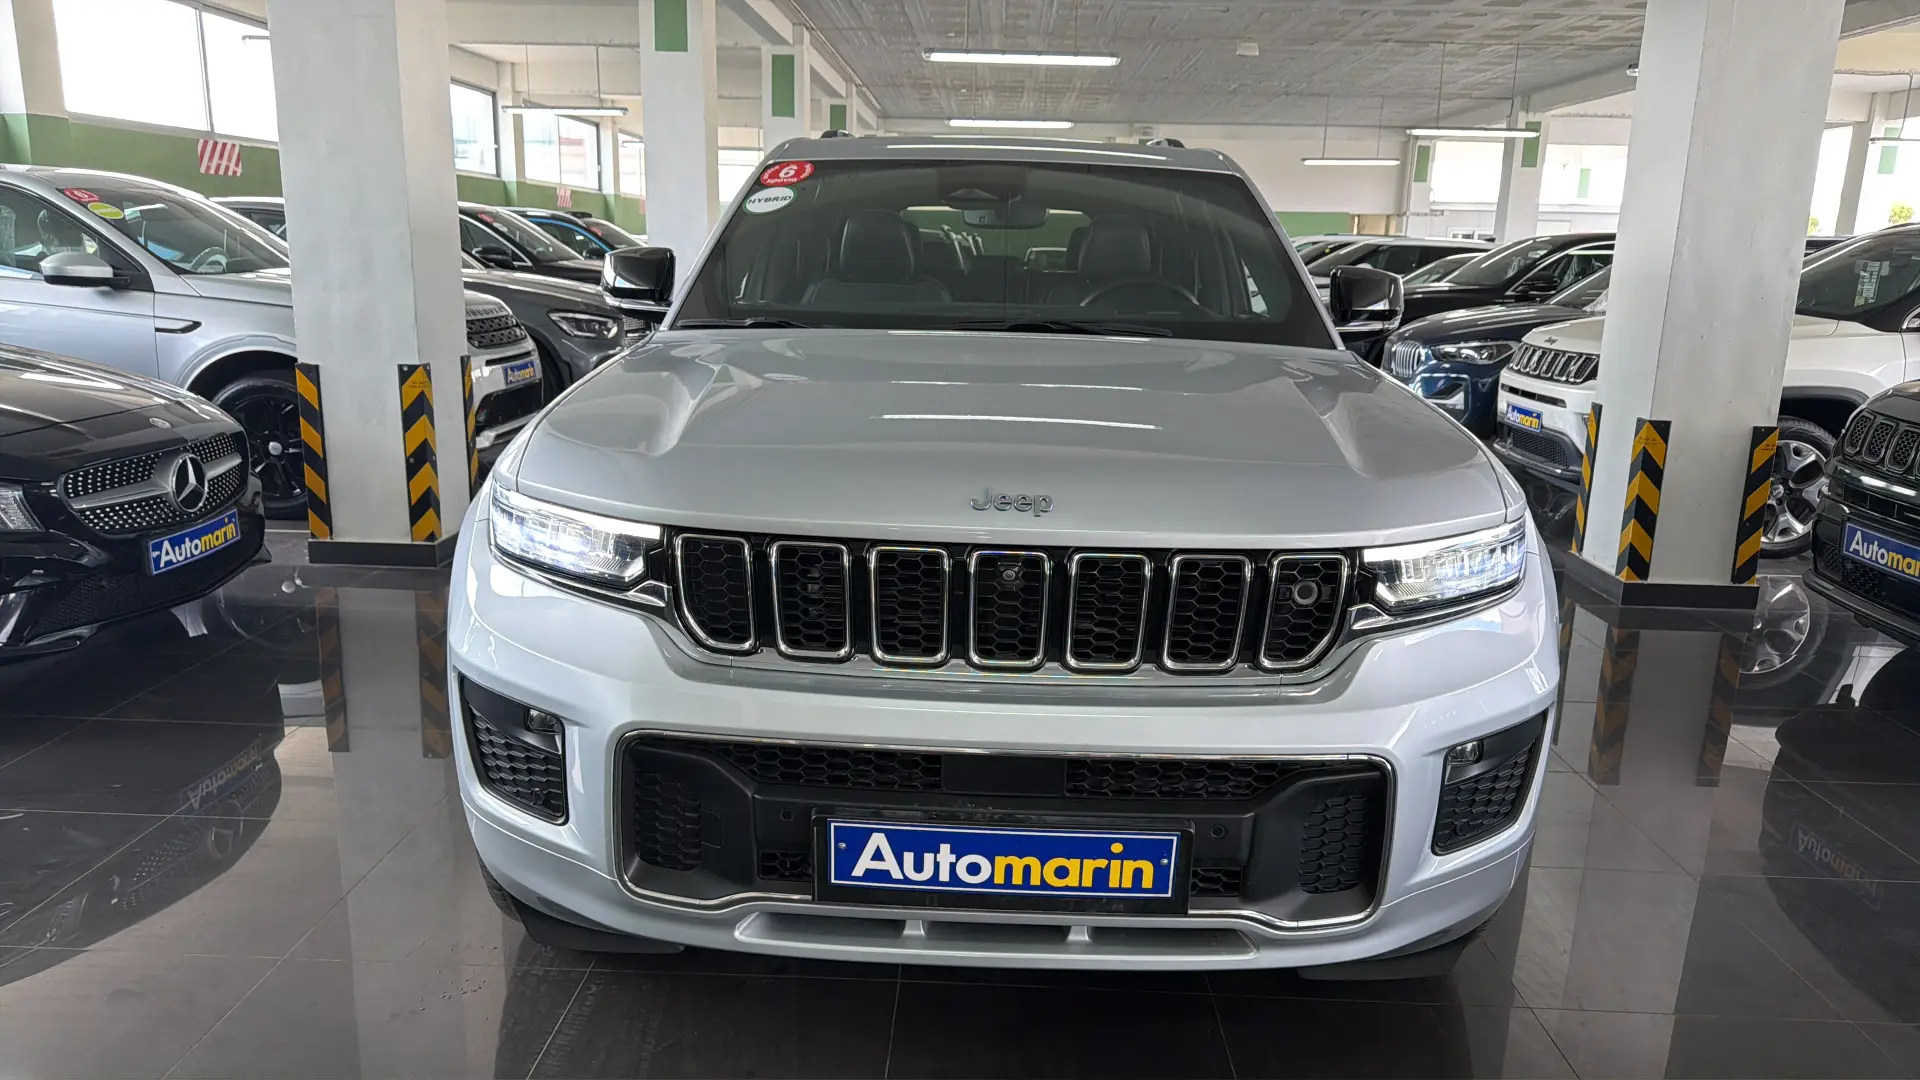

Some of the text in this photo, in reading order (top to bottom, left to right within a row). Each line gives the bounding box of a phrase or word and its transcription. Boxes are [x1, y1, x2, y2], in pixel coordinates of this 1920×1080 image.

[779, 164, 798, 178] 6
[748, 195, 791, 205] HYBRID
[1506, 404, 1539, 430] Automarin
[970, 486, 1054, 518] Jeep
[160, 517, 236, 568] Automarin
[851, 832, 1154, 889] Automarin
